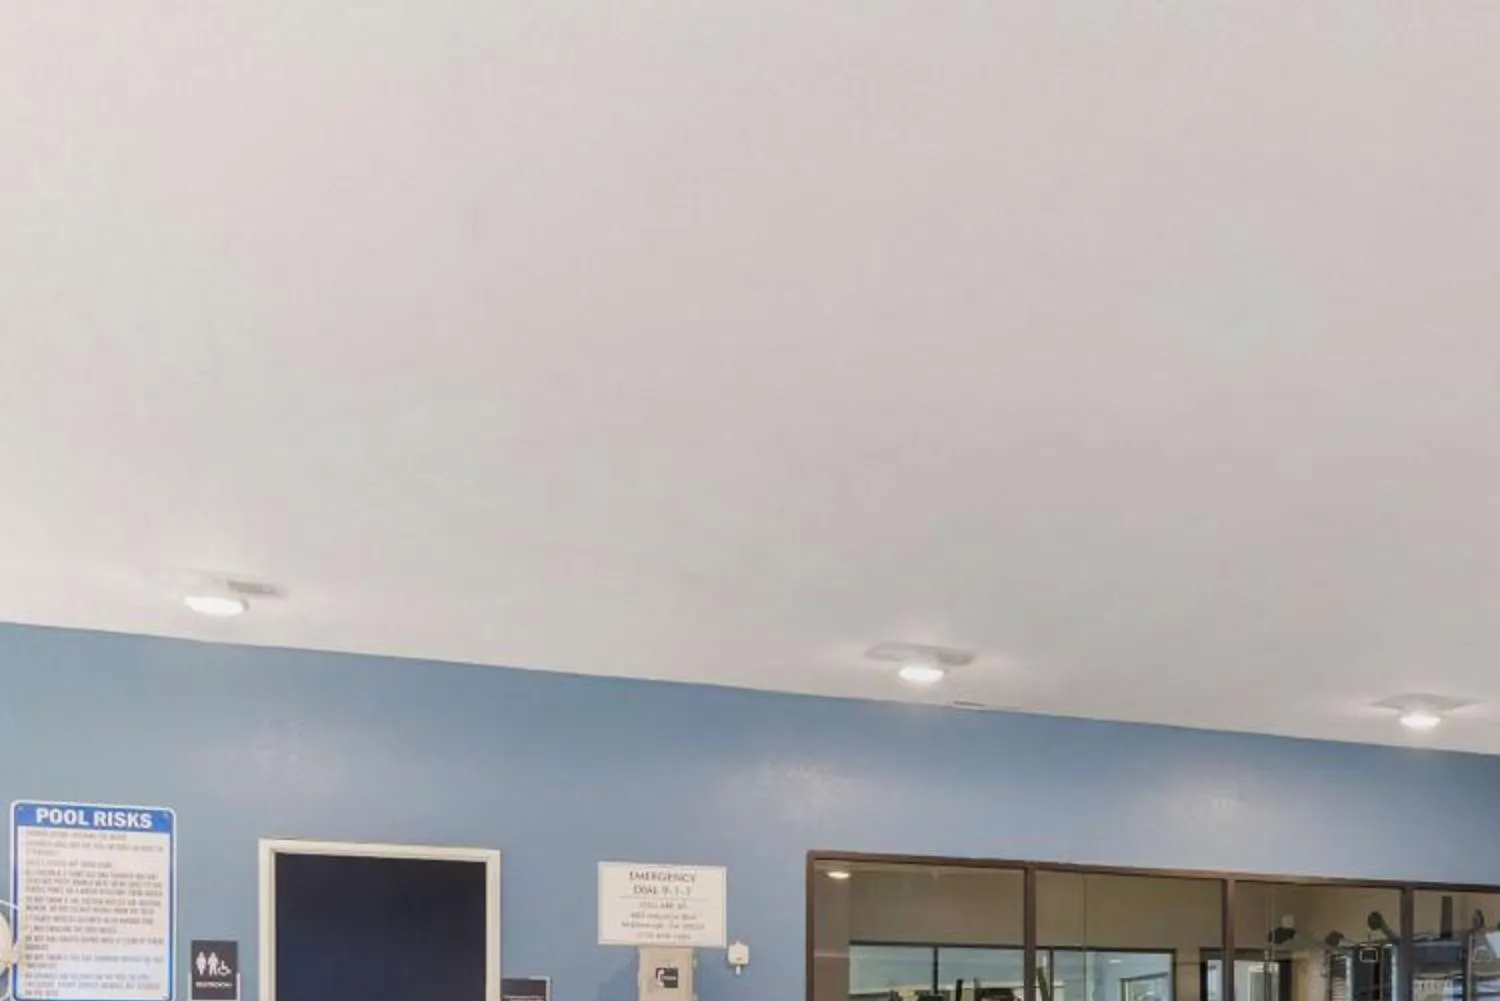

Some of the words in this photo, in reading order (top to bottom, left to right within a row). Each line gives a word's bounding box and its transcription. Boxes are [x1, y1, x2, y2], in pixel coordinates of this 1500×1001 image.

[36, 808, 89, 826] POOL
[94, 811, 153, 829] RISKS
[629, 871, 695, 882] EMERGENCY
[633, 884, 657, 895] DIAL
